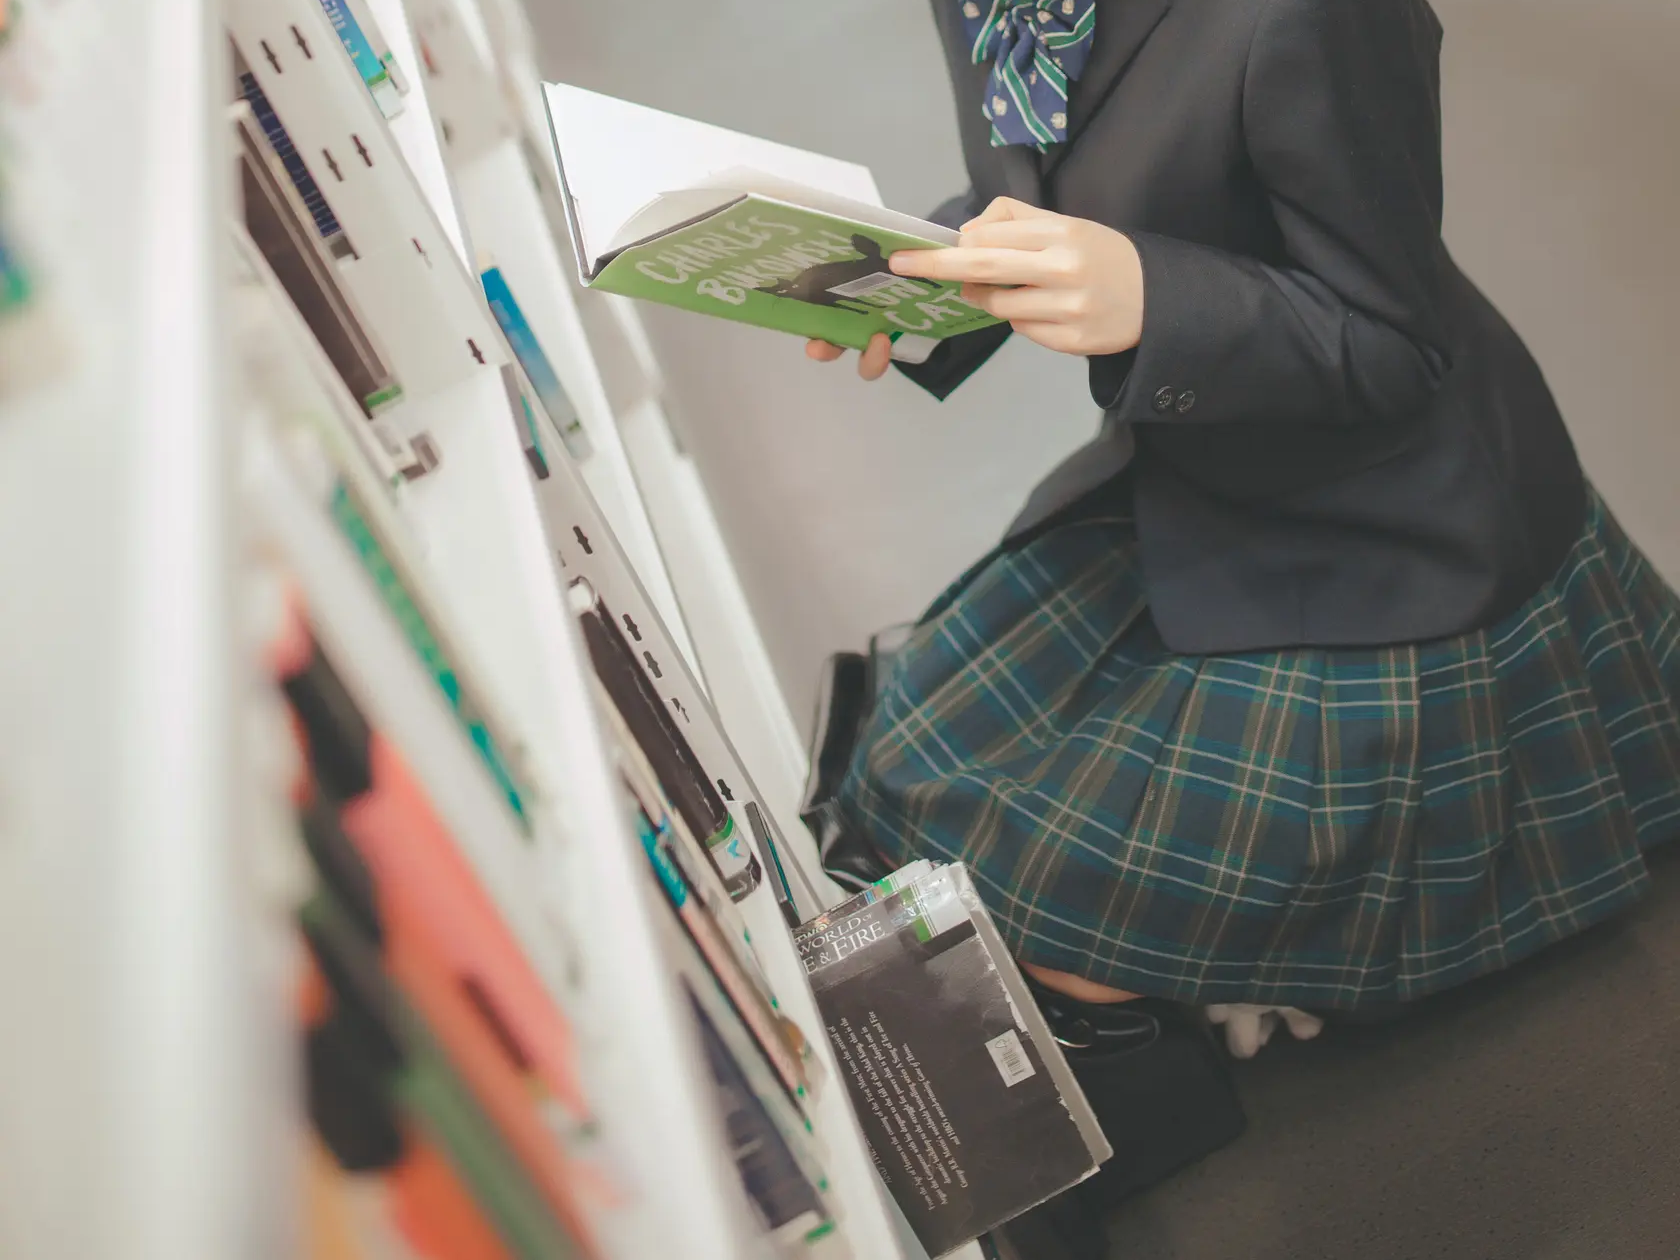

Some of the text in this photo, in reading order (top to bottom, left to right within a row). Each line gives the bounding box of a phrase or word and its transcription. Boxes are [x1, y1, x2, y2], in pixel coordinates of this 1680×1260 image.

[635, 216, 800, 284] CHARLES
[799, 917, 862, 956] WORLD
[819, 952, 831, 964] &
[831, 921, 885, 960] FIRE
[868, 1011, 878, 1023] Fire
[830, 1032, 846, 1050] arrival
[848, 1032, 858, 1043] this
[867, 1042, 886, 1060] played
[888, 1047, 900, 1063] Song
[848, 1059, 859, 1074] from
[883, 1066, 893, 1078] that
[900, 1068, 911, 1083] series
[877, 1087, 888, 1097] fall
[889, 1078, 904, 1094] power
[863, 1087, 874, 1102] First
[907, 1140, 918, 1153] with
